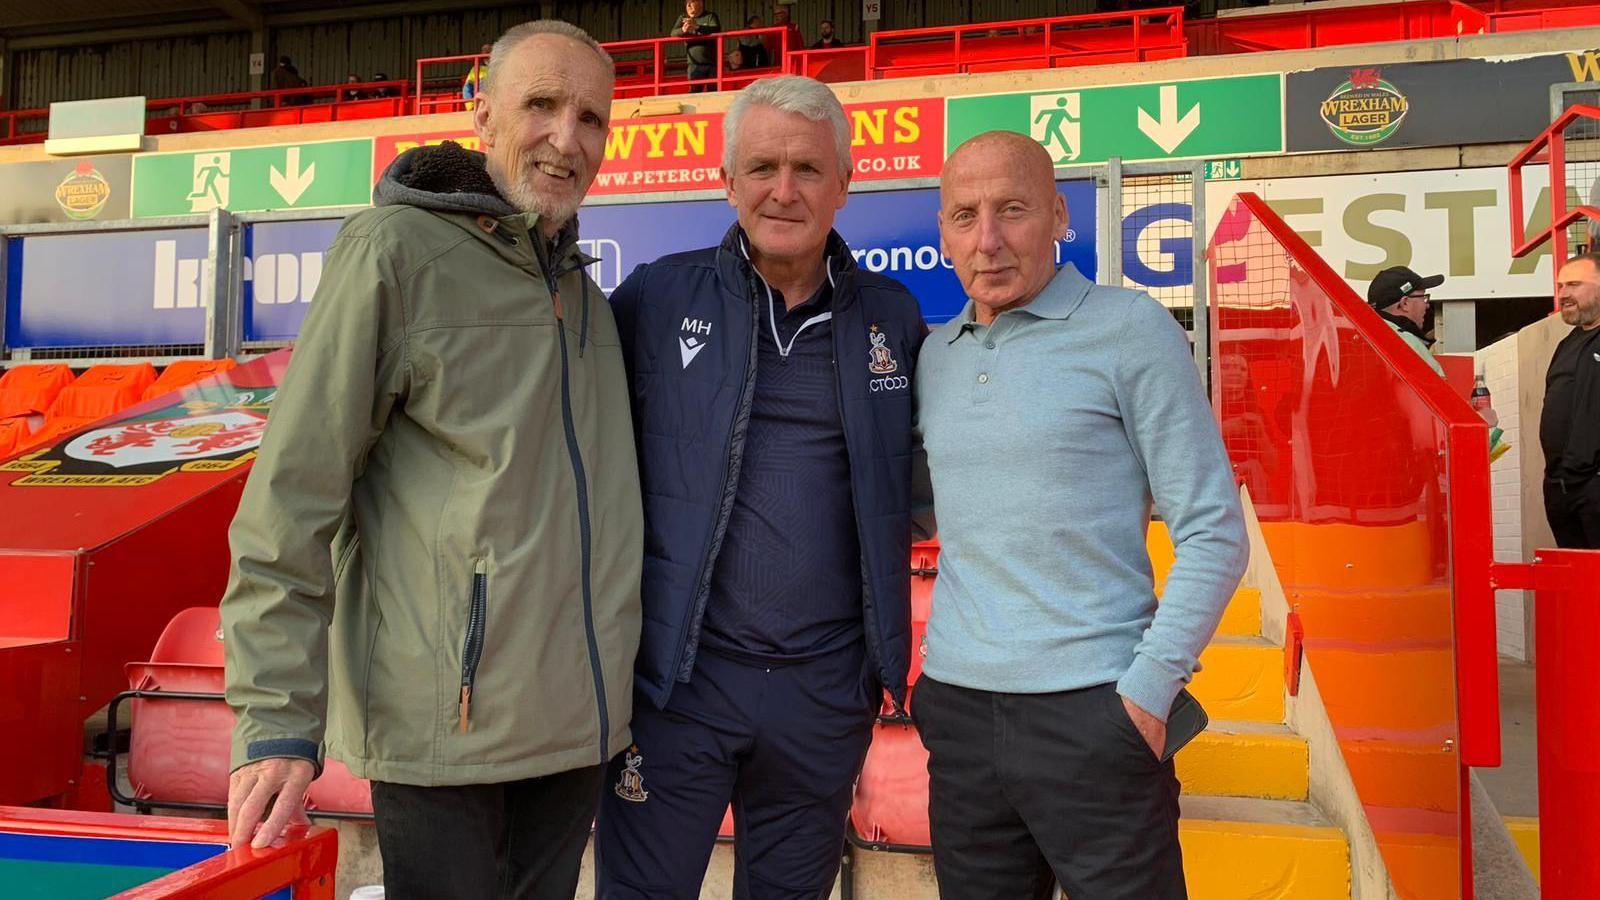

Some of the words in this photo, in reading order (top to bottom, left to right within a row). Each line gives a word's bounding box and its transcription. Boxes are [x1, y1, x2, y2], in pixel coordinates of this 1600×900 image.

[866, 3, 878, 14] Y5
[1321, 96, 1407, 116] WREXHAM
[1343, 113, 1387, 125] LAGER
[604, 120, 709, 160] WYN
[851, 106, 920, 147] NS
[681, 317, 712, 335] MH
